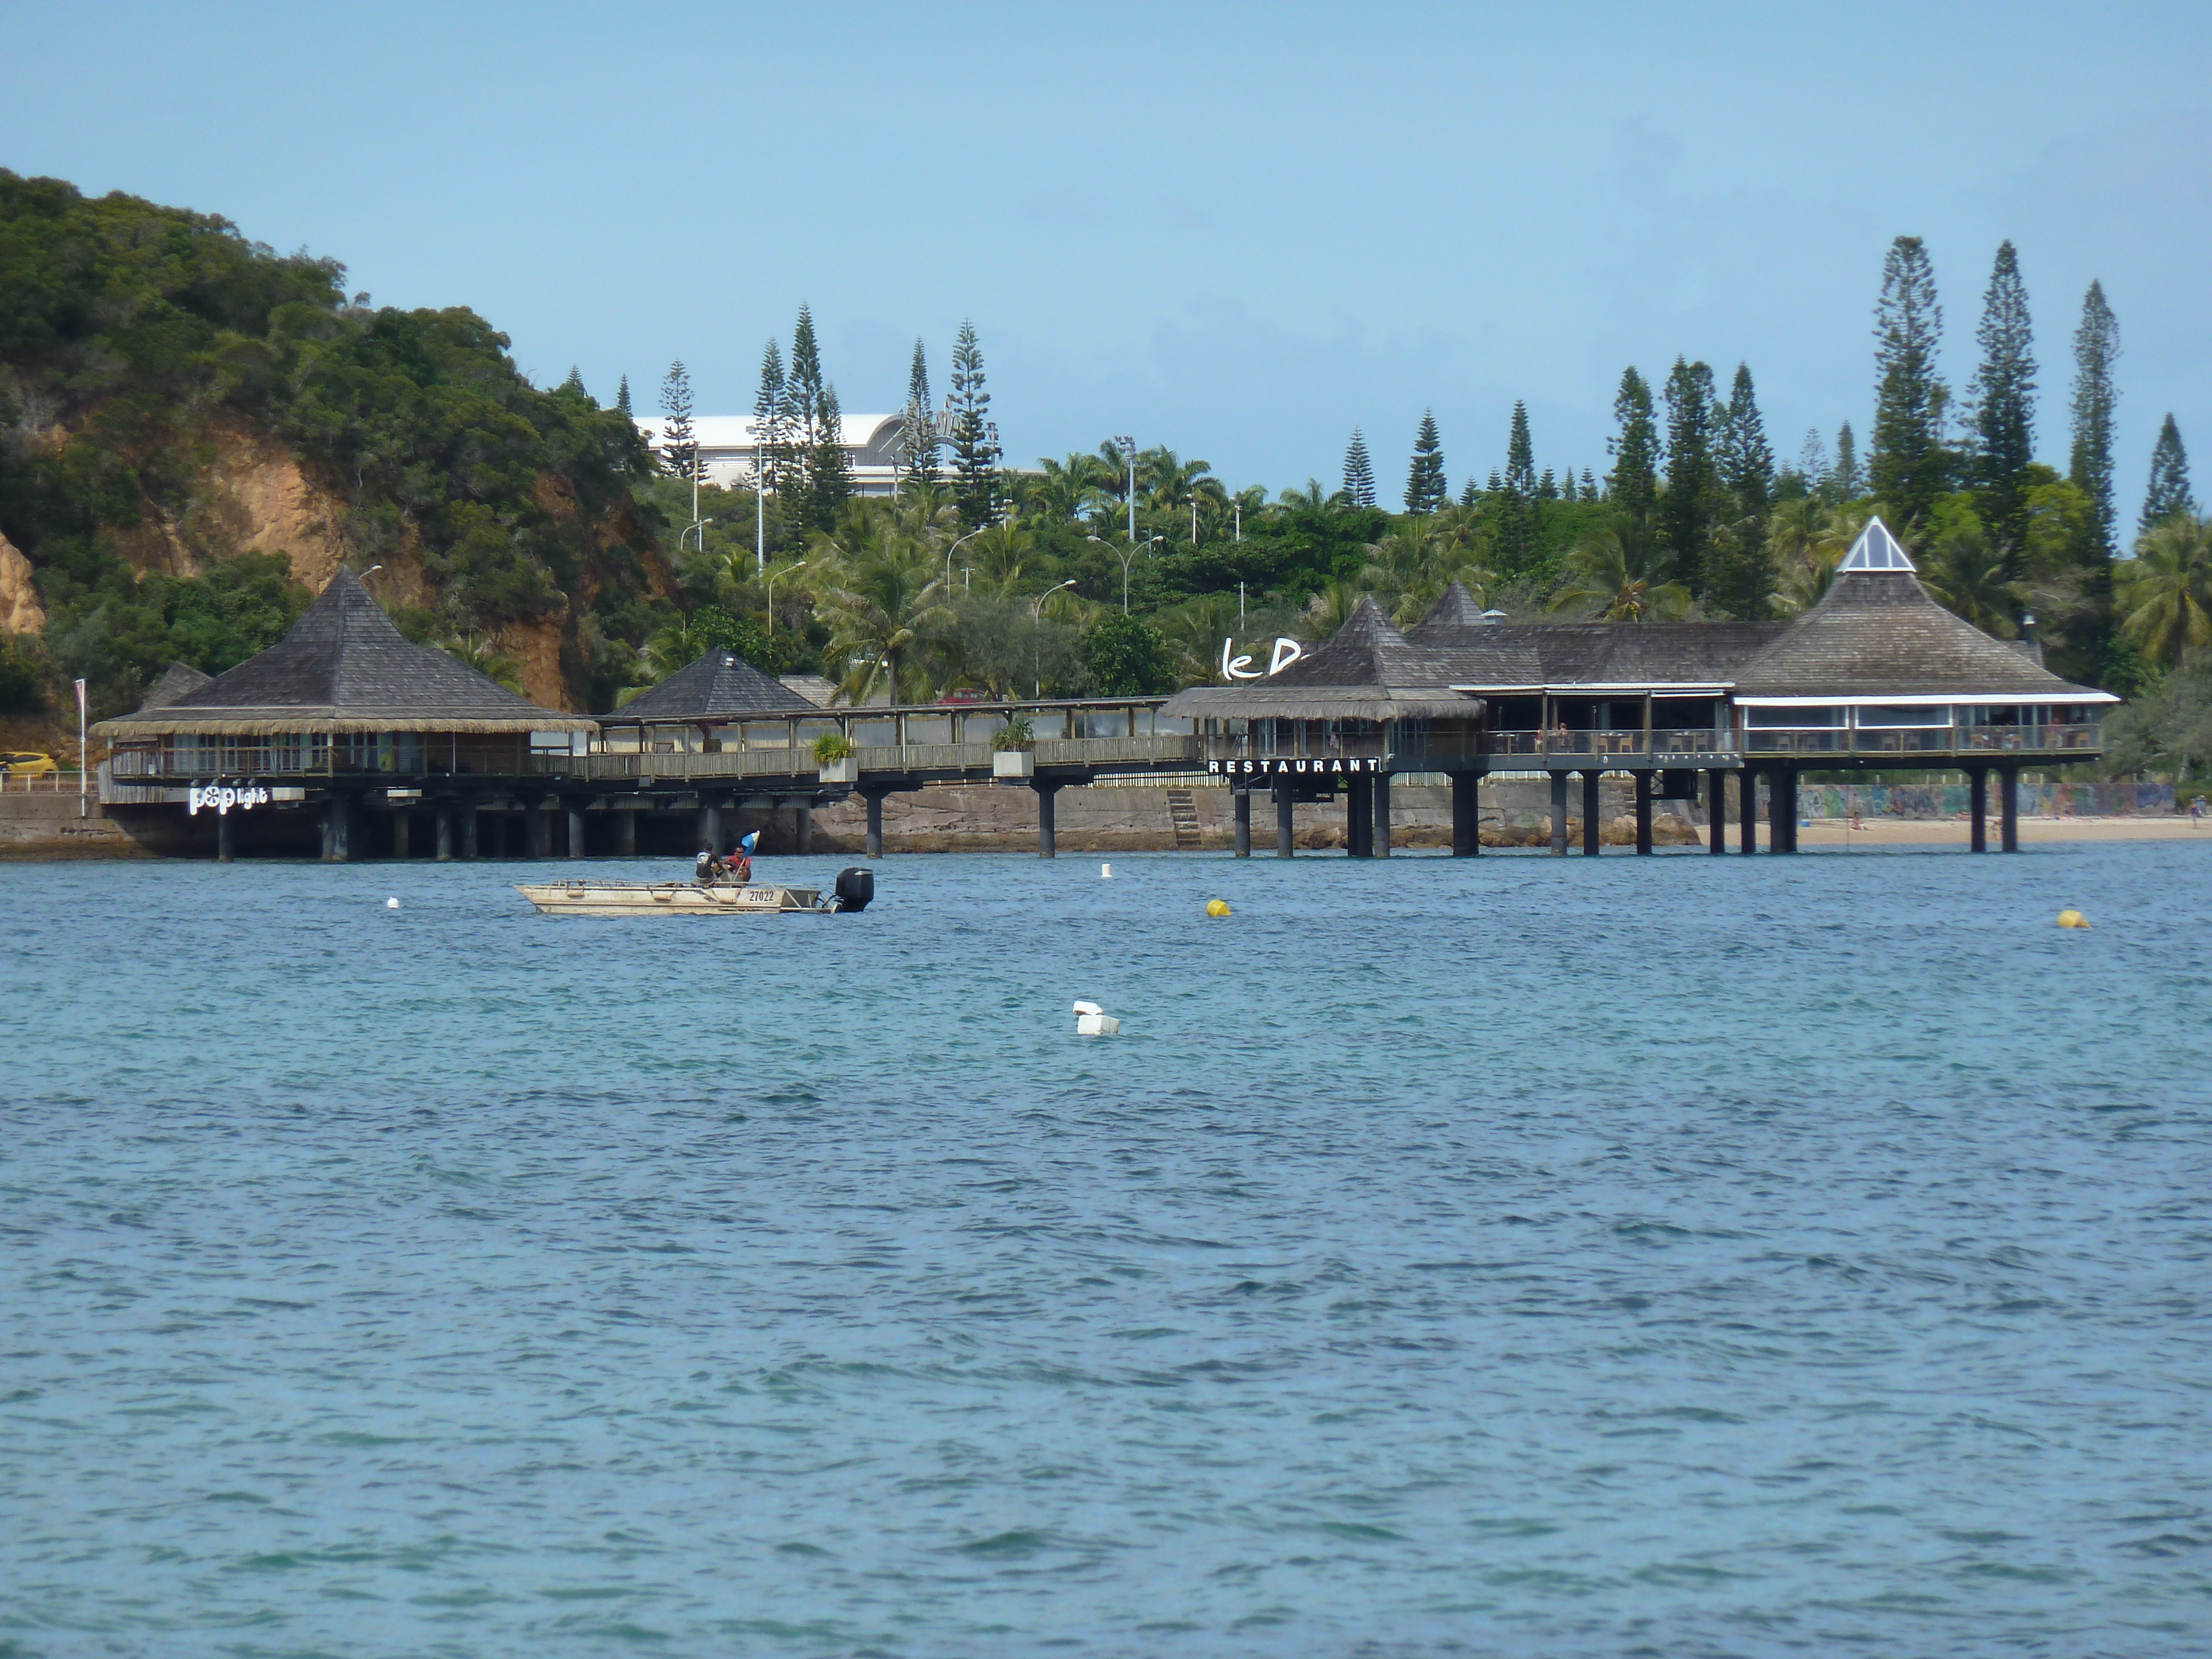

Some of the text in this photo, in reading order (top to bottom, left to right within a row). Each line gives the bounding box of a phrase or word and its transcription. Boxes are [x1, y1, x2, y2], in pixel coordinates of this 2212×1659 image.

[1223, 637, 1264, 681] le
[1209, 759, 1378, 773] RESTAURANT
[237, 787, 267, 810] light
[749, 890, 774, 901] 27022
